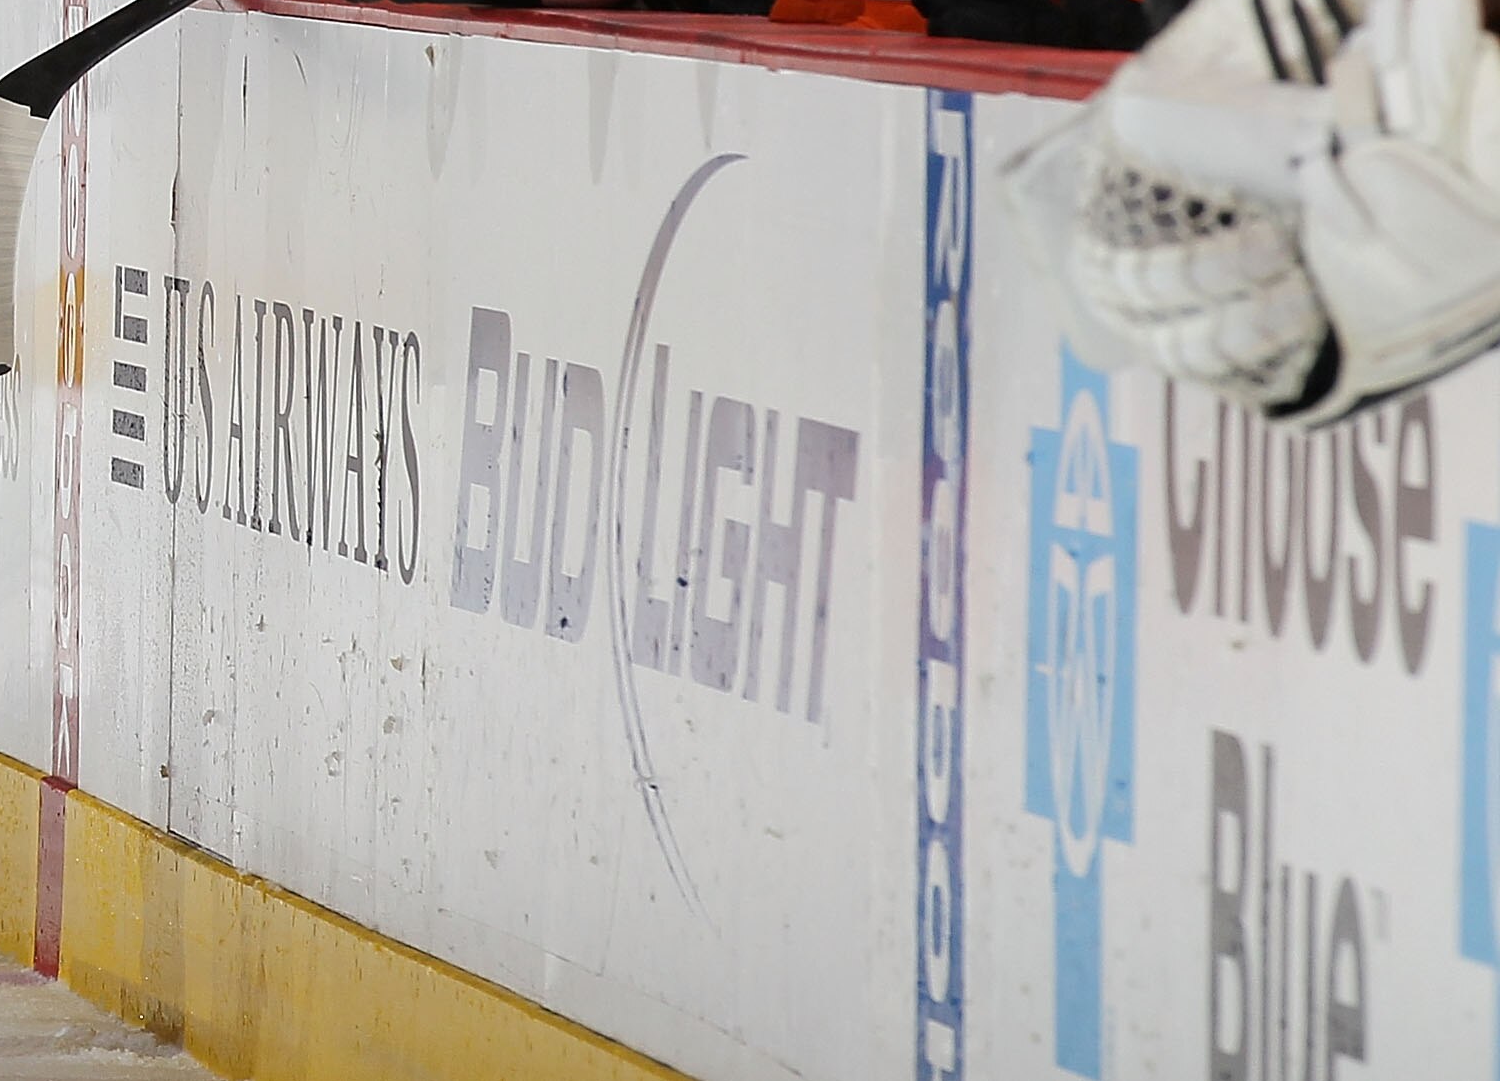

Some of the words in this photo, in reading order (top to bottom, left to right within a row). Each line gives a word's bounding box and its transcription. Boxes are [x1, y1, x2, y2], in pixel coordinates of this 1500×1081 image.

[221, 291, 422, 586] AIRWAYS
[448, 305, 607, 646] BUD
[631, 343, 861, 725] LIGHT
[1210, 728, 1367, 1081] Blue
